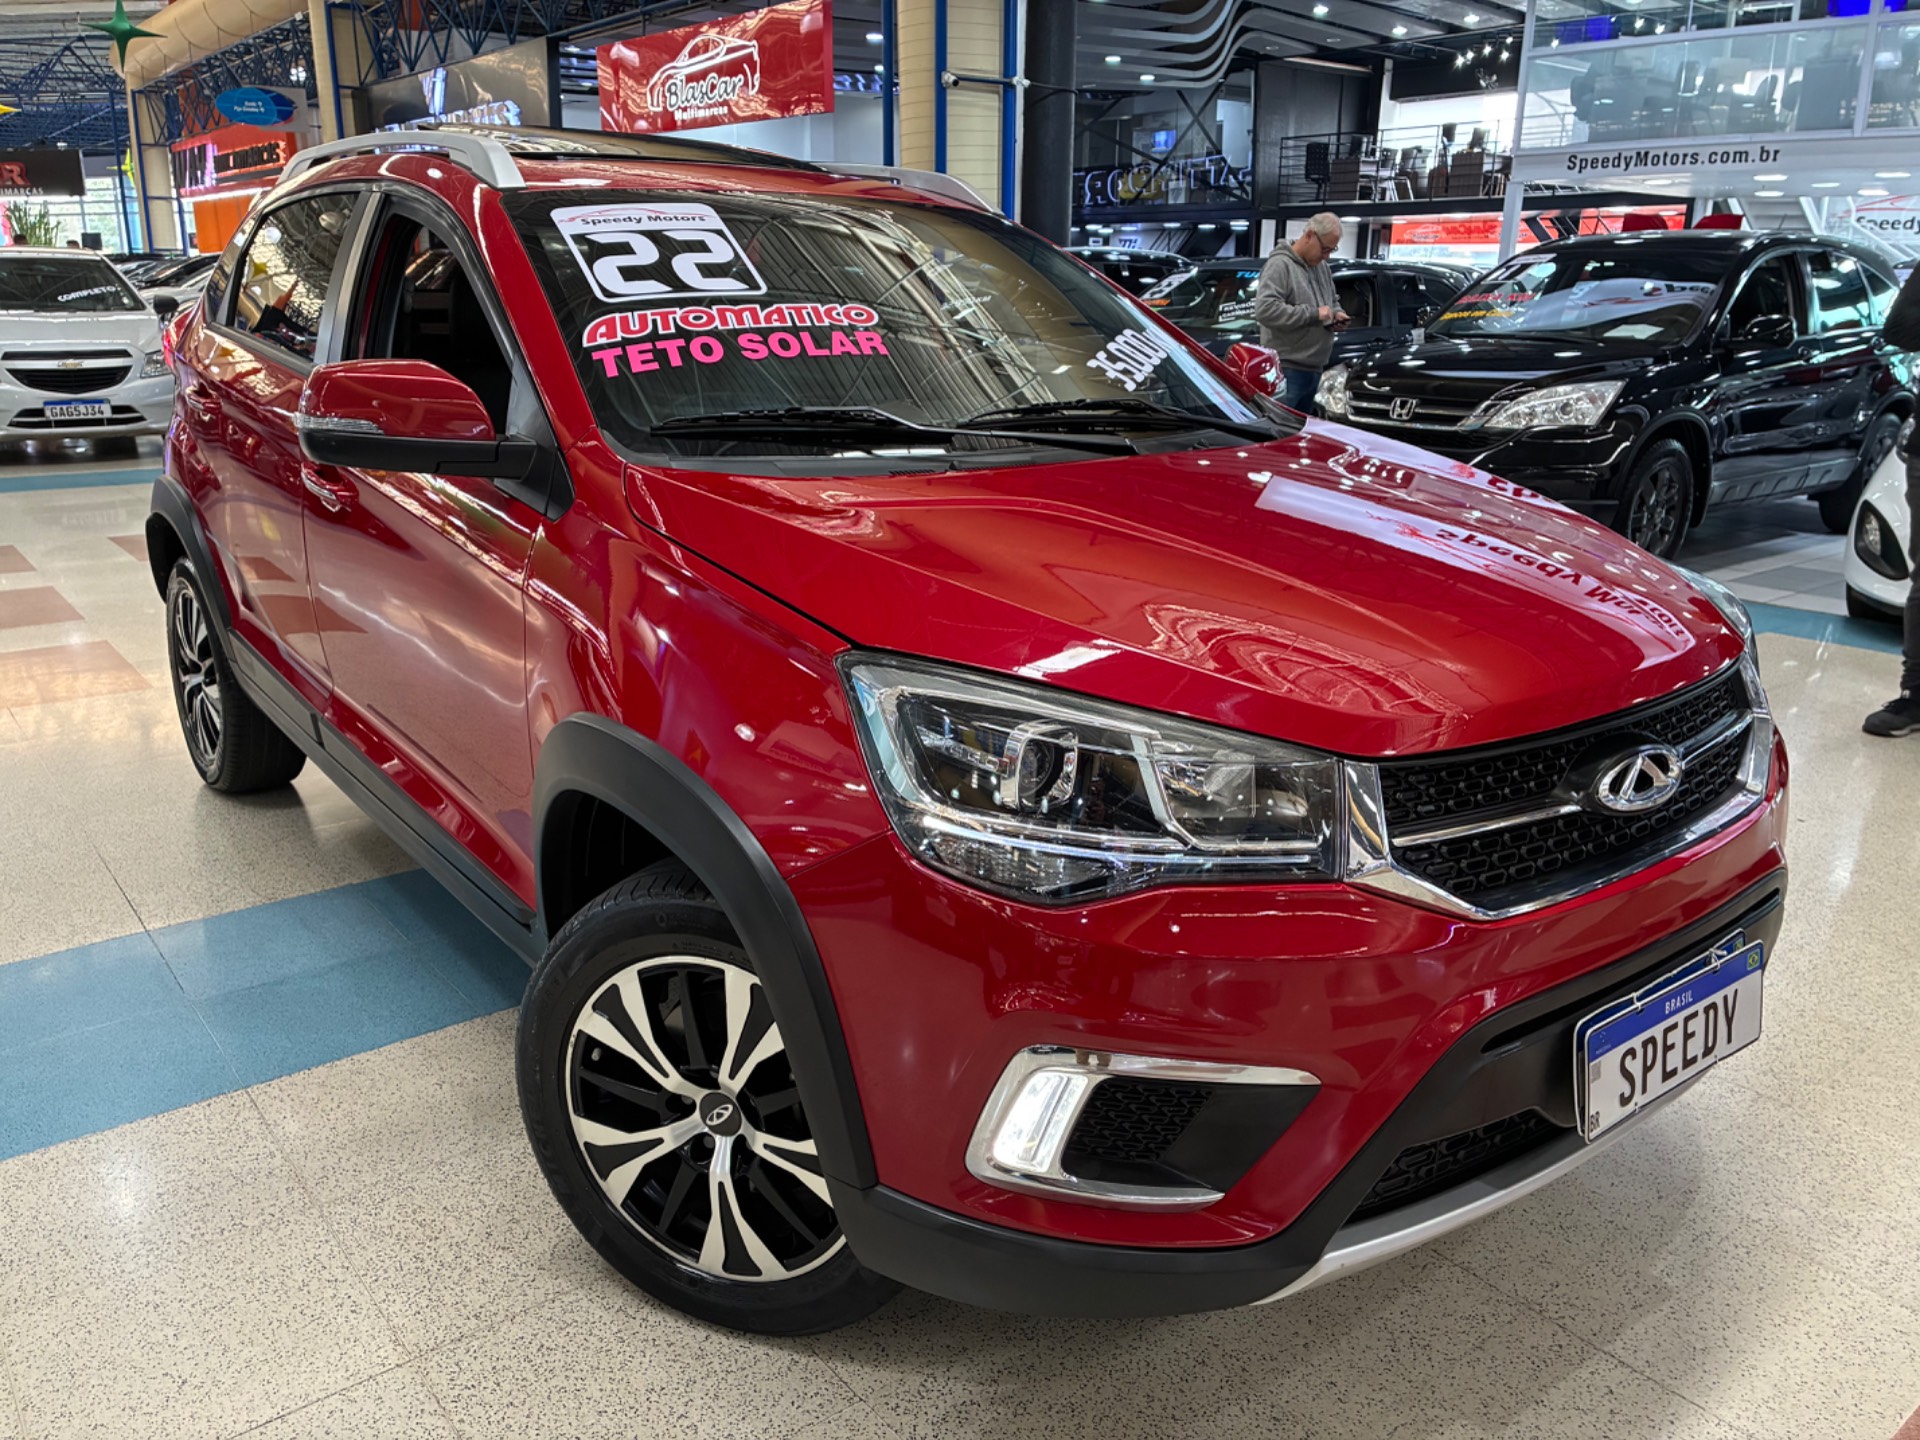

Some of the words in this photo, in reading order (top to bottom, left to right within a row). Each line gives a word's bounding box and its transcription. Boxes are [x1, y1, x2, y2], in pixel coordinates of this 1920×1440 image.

[1566, 146, 1780, 173] SpeedyMotors.com.br
[580, 215, 642, 226] Speedy
[646, 215, 706, 223] Motors
[585, 230, 750, 295] 22
[57, 285, 116, 302] COMPLETO
[582, 304, 878, 348] AUTOMATICO
[591, 336, 724, 379] TETO
[739, 331, 889, 360] SOLAR
[50, 405, 104, 418] GAG5J34
[1665, 990, 1694, 1014] BRASIL
[1619, 988, 1738, 1108] SPEEDY
